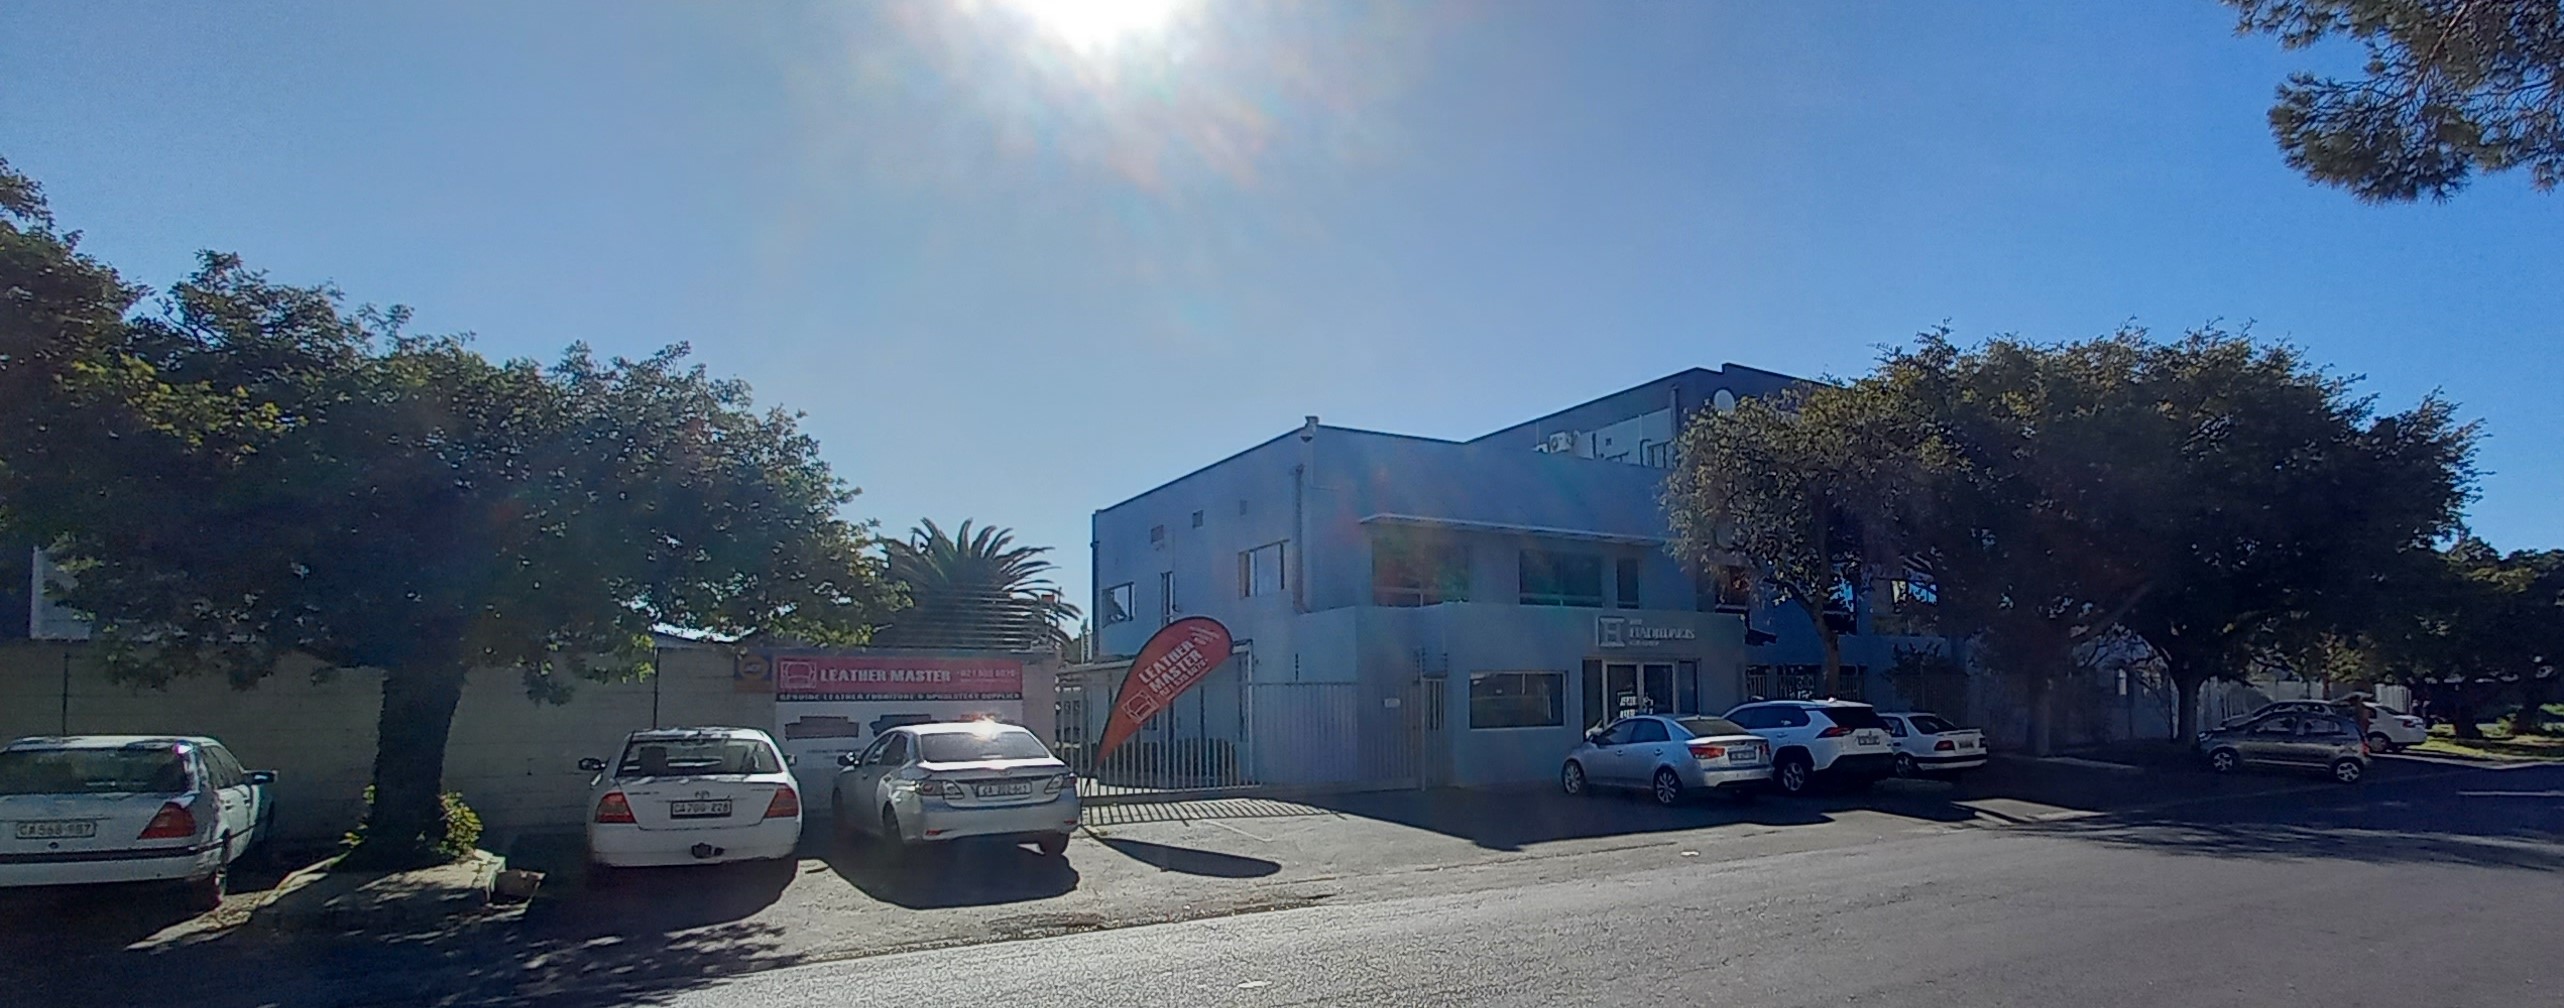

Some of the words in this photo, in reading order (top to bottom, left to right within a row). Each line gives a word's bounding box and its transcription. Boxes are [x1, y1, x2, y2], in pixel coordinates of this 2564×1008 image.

[820, 669, 887, 682] LEATHER
[890, 669, 951, 682] MASTER
[1138, 640, 1195, 684] LEATHER
[1148, 649, 1203, 694] MASTER
